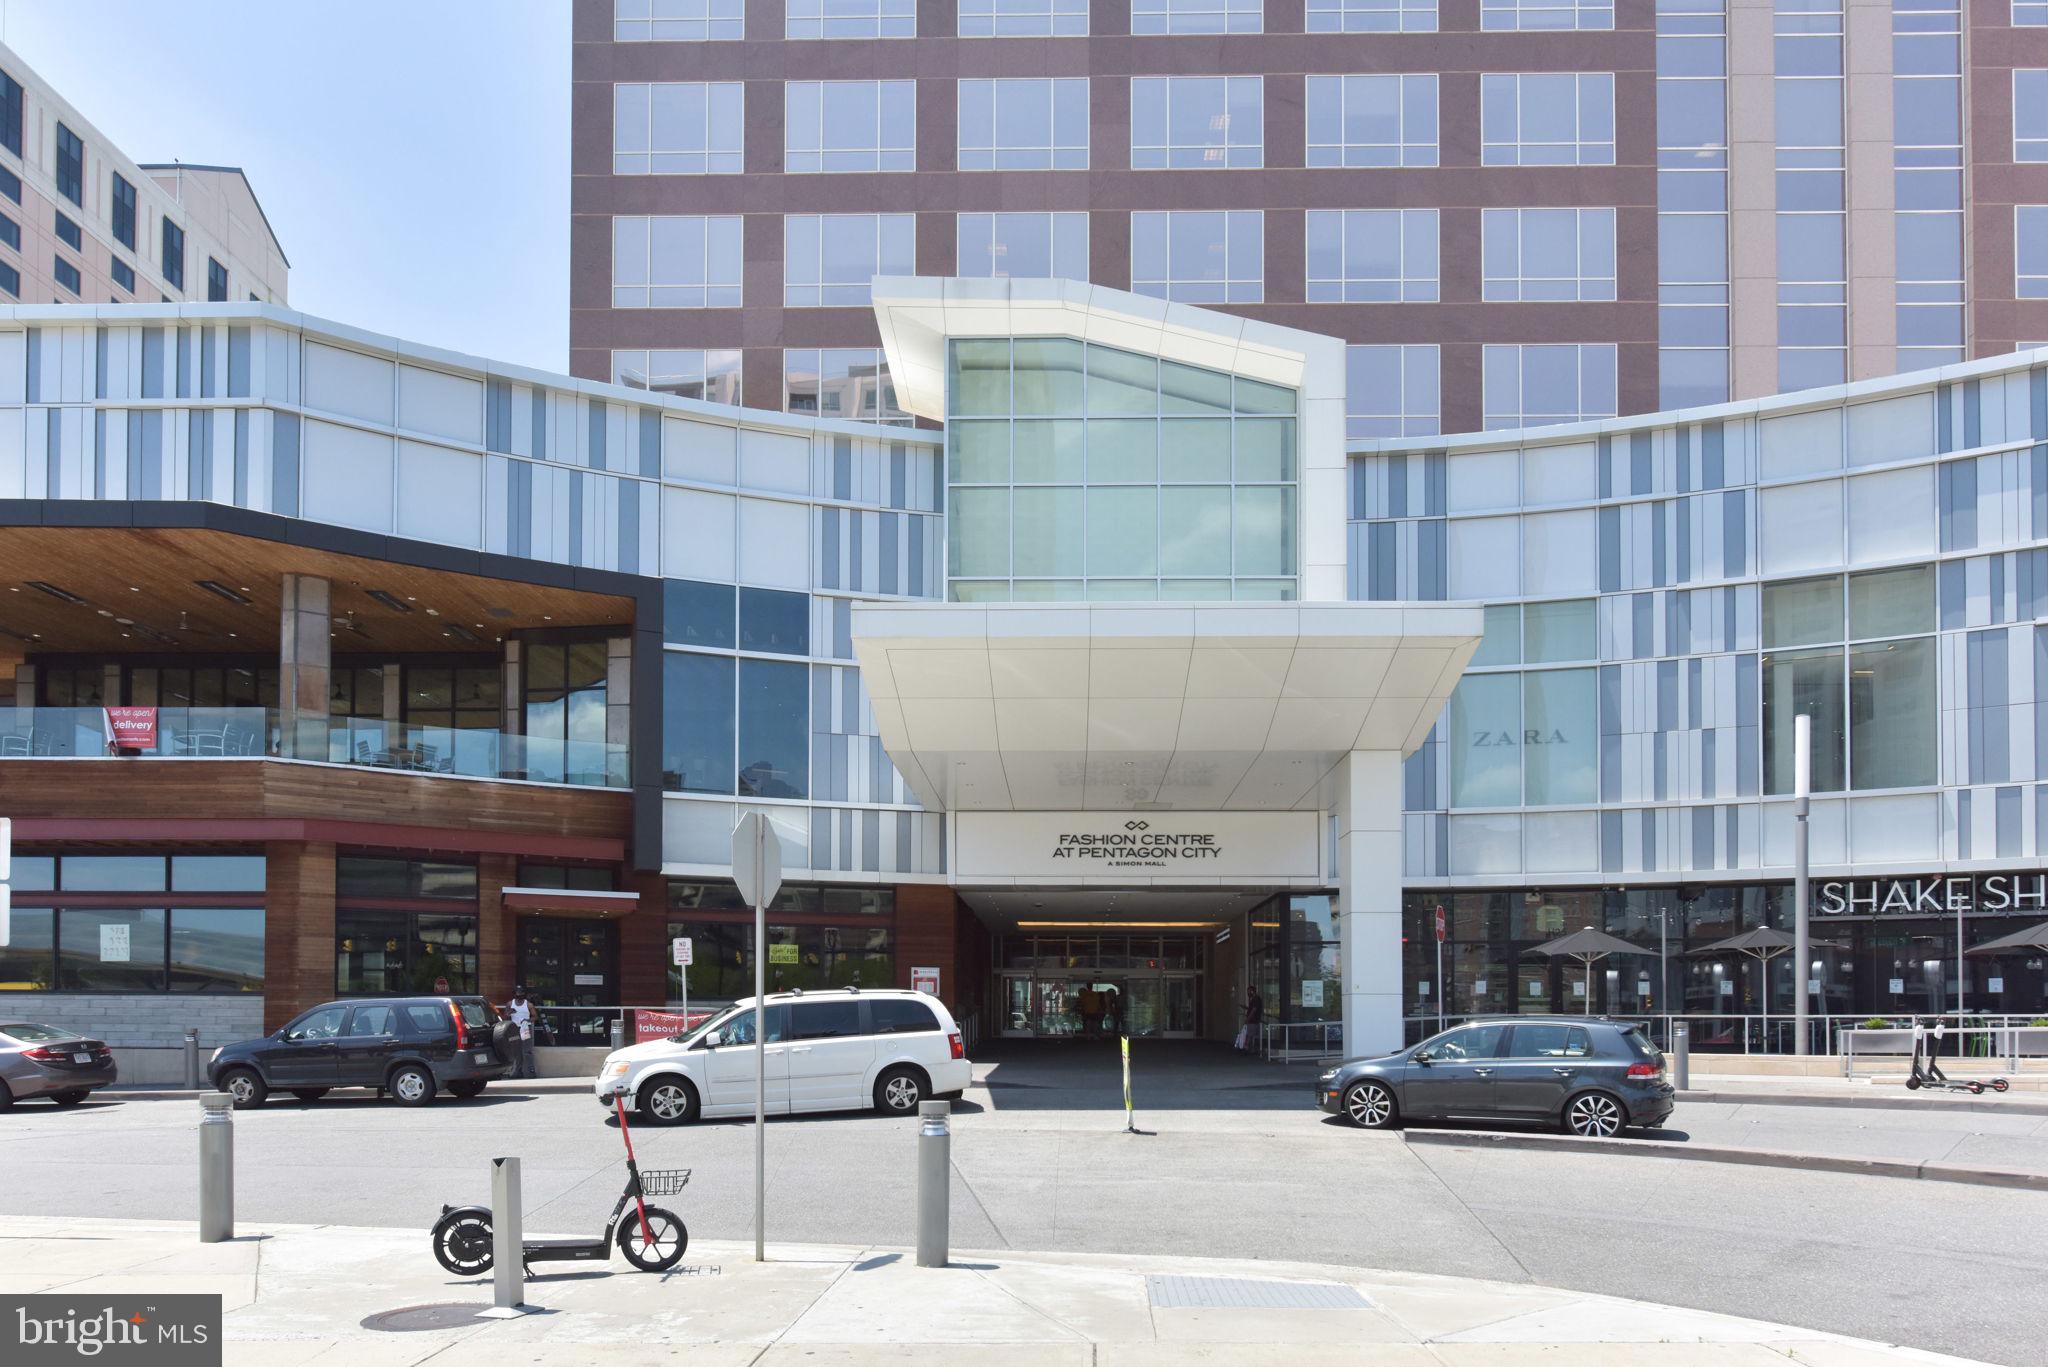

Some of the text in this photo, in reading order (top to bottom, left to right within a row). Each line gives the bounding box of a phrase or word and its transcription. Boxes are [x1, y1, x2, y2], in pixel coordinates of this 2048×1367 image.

[113, 720, 153, 731] delivery
[1472, 728, 1569, 747] ZARA
[1059, 834, 1215, 845] FASHION CENTRE
[1052, 847, 1222, 858] AT PENTAGON CITY
[1821, 874, 2046, 914] SHAKE SH
[639, 1023, 678, 1034] takeout
